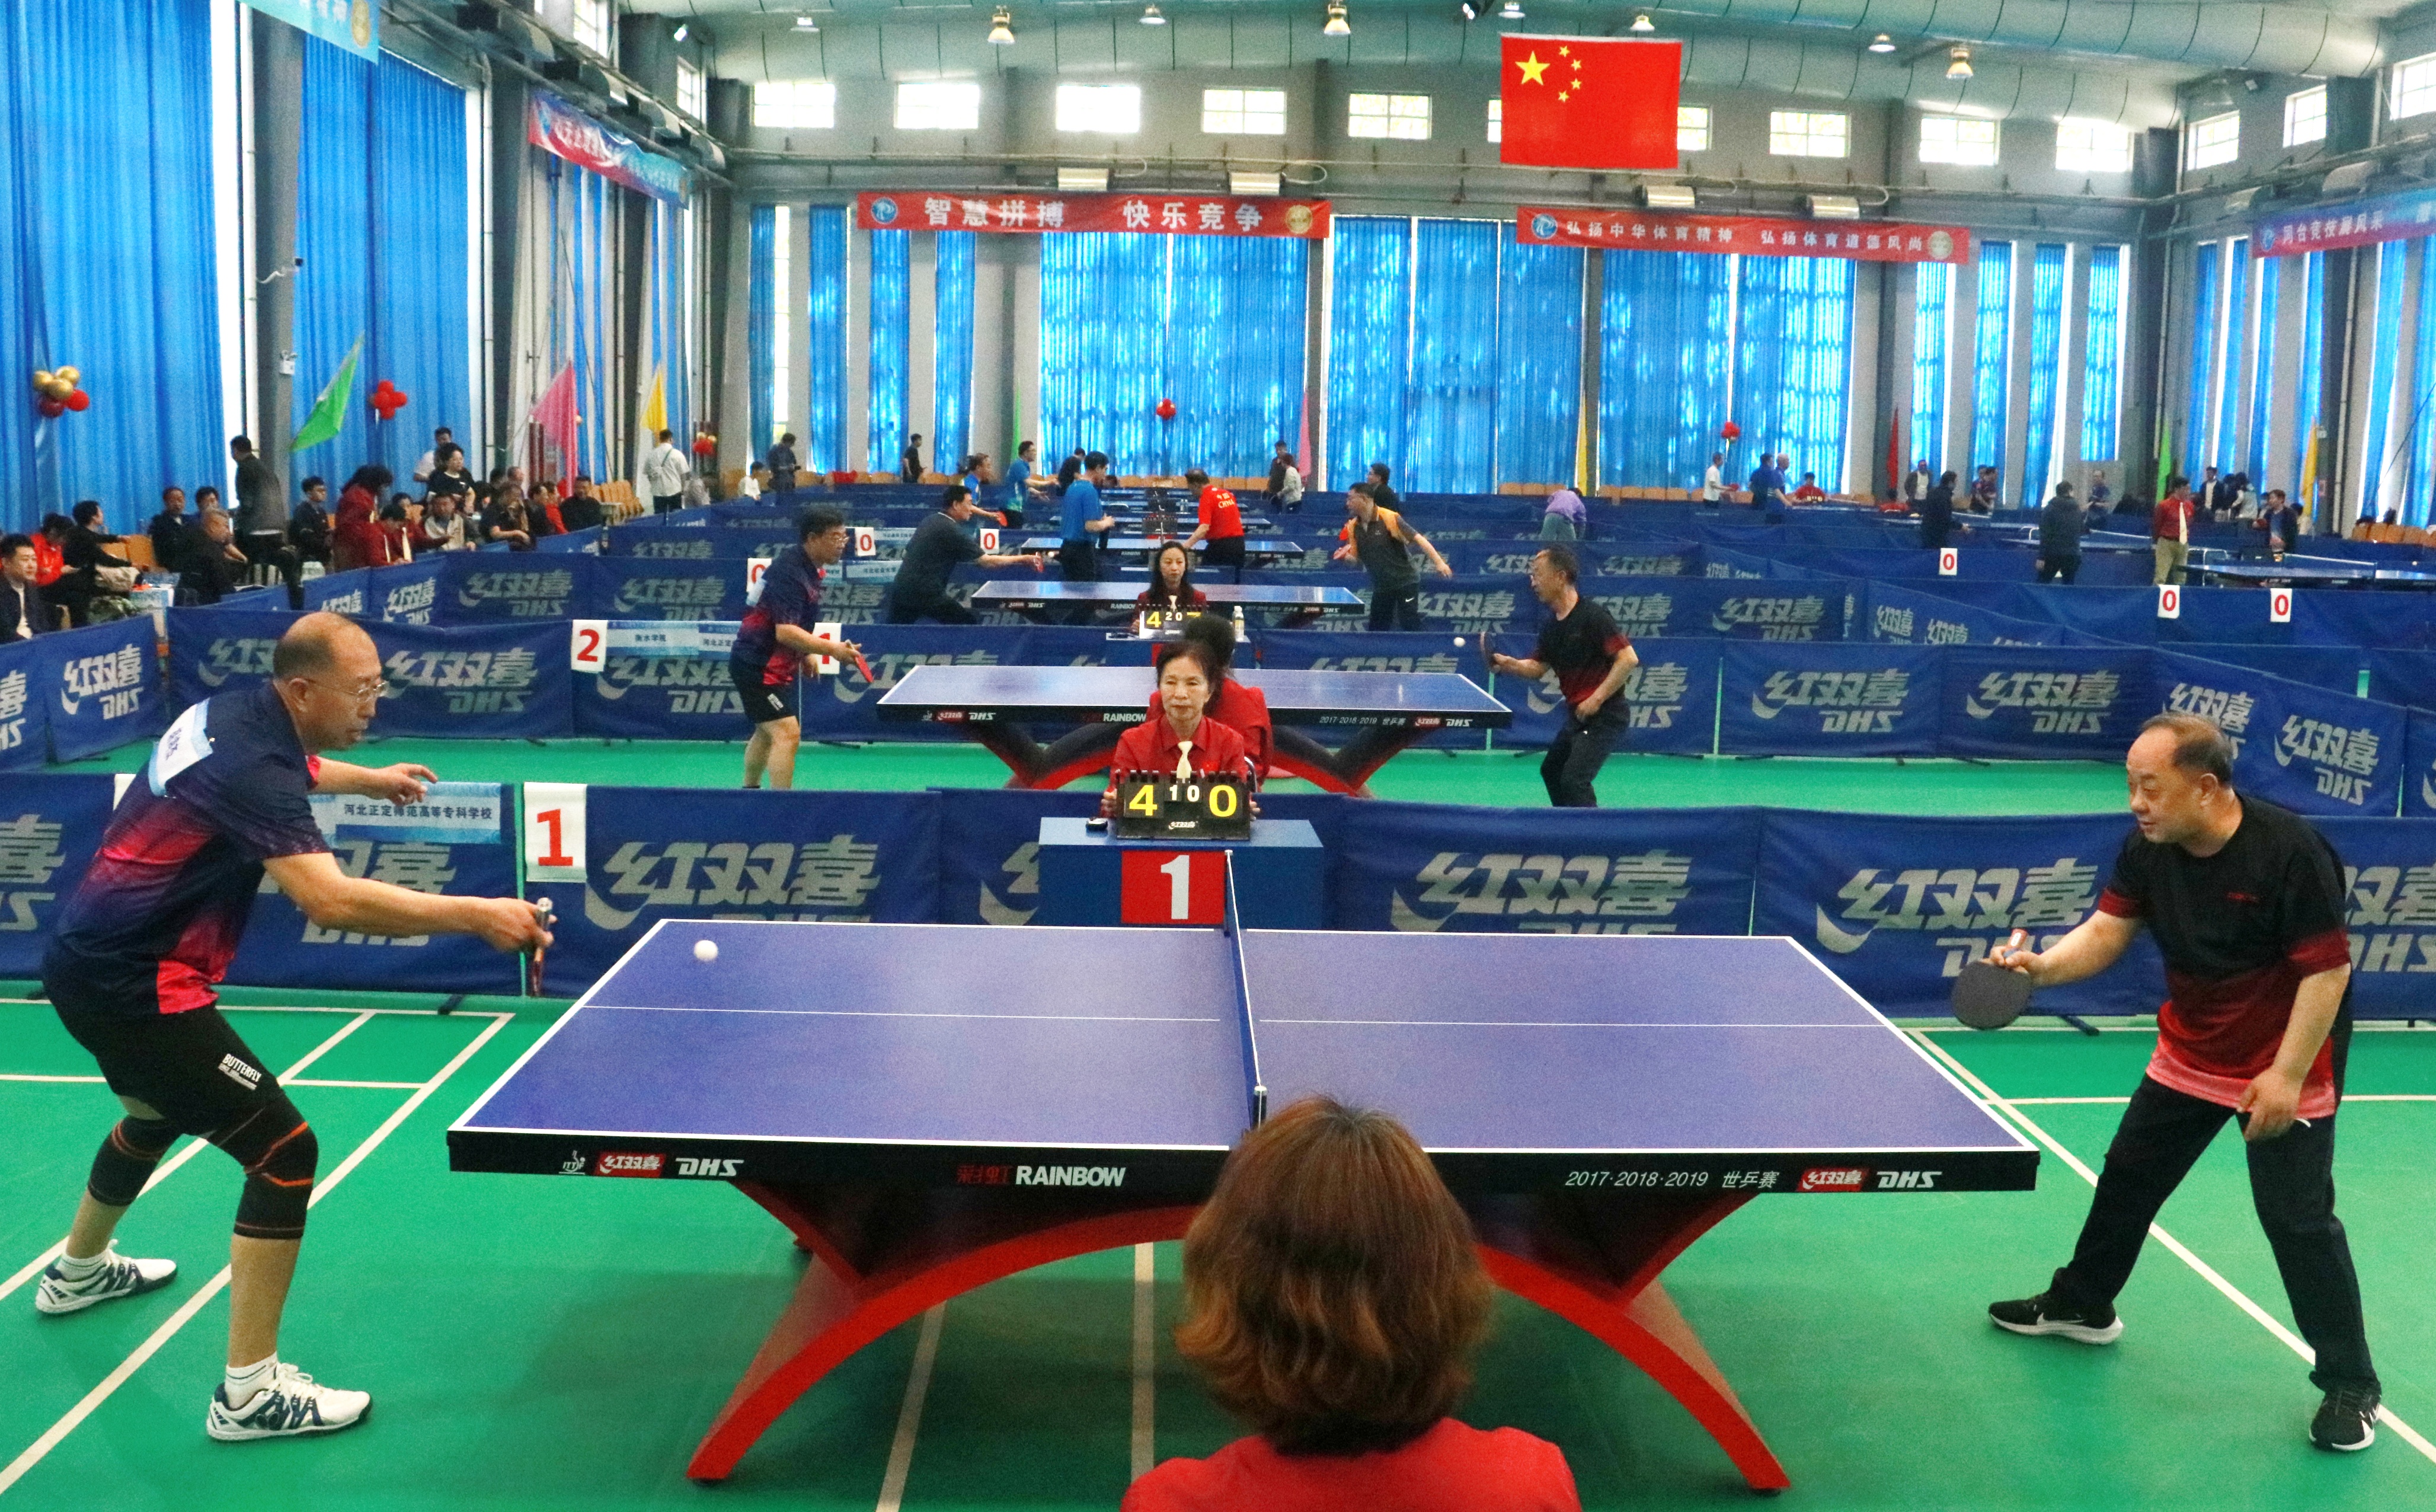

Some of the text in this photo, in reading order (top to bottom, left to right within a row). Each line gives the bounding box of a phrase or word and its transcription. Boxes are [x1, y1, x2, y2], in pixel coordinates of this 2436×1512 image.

[925, 197, 1263, 232] 智慧拼搏 快乐竞争
[860, 534, 872, 551] 0
[983, 532, 996, 549] 0
[1943, 553, 1955, 570] 0
[387, 577, 436, 613] 红双喜
[467, 569, 573, 598] 红双喜
[622, 576, 726, 605] 红双喜
[509, 600, 569, 616] DHS
[1721, 596, 1824, 623] 红双喜
[2163, 590, 2176, 611] 0
[2275, 594, 2288, 616] 0
[1146, 611, 1162, 628] 4
[1165, 612, 1172, 621] 2
[1175, 612, 1183, 621] 0
[1761, 624, 1819, 641] DHS
[577, 629, 600, 662] 2
[63, 644, 143, 696] 红双喜
[385, 647, 538, 686] 红双喜
[445, 691, 533, 713] DHS
[1764, 668, 1910, 707] 红双喜
[1979, 670, 2120, 708] 红双喜
[100, 686, 143, 720] DHS
[1103, 713, 1147, 721] RAINBOW
[1819, 711, 1903, 733] DHS
[2031, 711, 2111, 734] DHS
[2282, 714, 2380, 775] 红双喜
[1129, 785, 1237, 817] 4 1 0 0
[2314, 767, 2373, 805] DHS
[344, 804, 493, 819] 河北正定师范高等专科学校
[537, 808, 573, 867] 1
[603, 835, 881, 905] 红双喜
[1416, 849, 1693, 916] 红双喜
[1161, 855, 1190, 920] 1
[1838, 858, 2098, 929] 红双喜
[222, 1053, 261, 1082] BUTTERFLY
[603, 1155, 660, 1170] 红双喜
[674, 1158, 744, 1177] DHS
[1015, 1165, 1126, 1186] RAINBOW
[1565, 1171, 1709, 1186] 2017·2018·2019
[1722, 1170, 1779, 1188] 世乒赛
[1808, 1169, 1862, 1185] 红双喜
[1876, 1171, 1942, 1188] DHS
